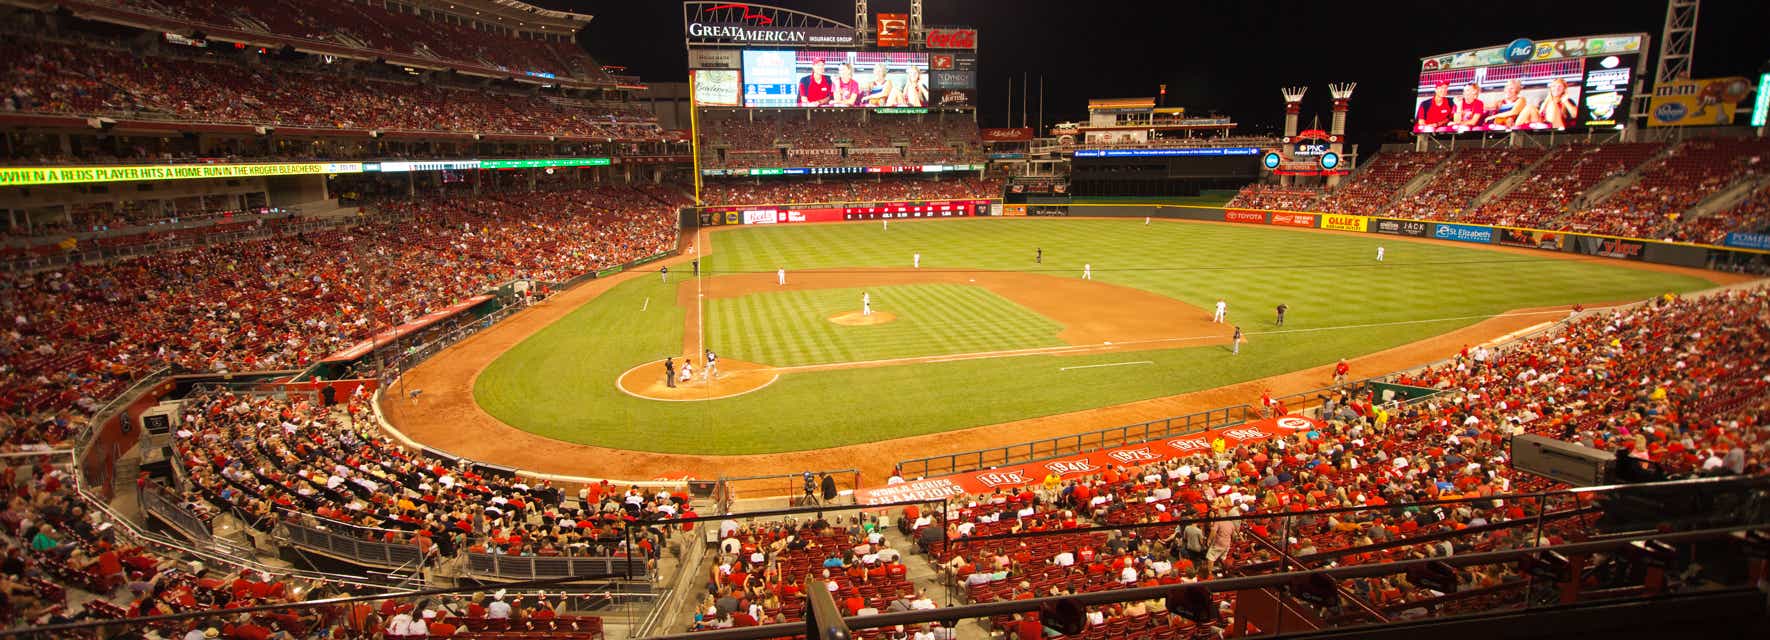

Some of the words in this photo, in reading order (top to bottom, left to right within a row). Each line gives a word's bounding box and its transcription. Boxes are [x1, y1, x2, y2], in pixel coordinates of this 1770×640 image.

[689, 22, 740, 37] GREAT
[734, 28, 806, 42] AMERICAN
[1510, 45, 1532, 57] P&G
[0, 170, 44, 183] WHEN
[49, 170, 58, 182] A
[60, 169, 94, 181] REDS
[95, 168, 139, 181] PLAYER
[140, 168, 164, 179] HITS
[165, 168, 173, 178] A
[175, 166, 203, 178] HOME
[203, 166, 222, 177] RUN
[222, 166, 232, 176] IN
[233, 165, 249, 176] THE
[250, 165, 278, 175] KROGER
[1238, 212, 1263, 220] TOYOTA
[1328, 217, 1361, 227] OLLIE'S
[1403, 222, 1425, 231] JACK
[1458, 229, 1491, 238] Elizabeth
[1171, 438, 1211, 450] 1976
[1112, 448, 1152, 461] 1975
[1050, 460, 1089, 473] 1940
[981, 472, 1022, 485] 1919
[869, 485, 910, 497] WORLD
[911, 478, 953, 492] SERIES
[869, 485, 965, 505] CHAMPIONS
